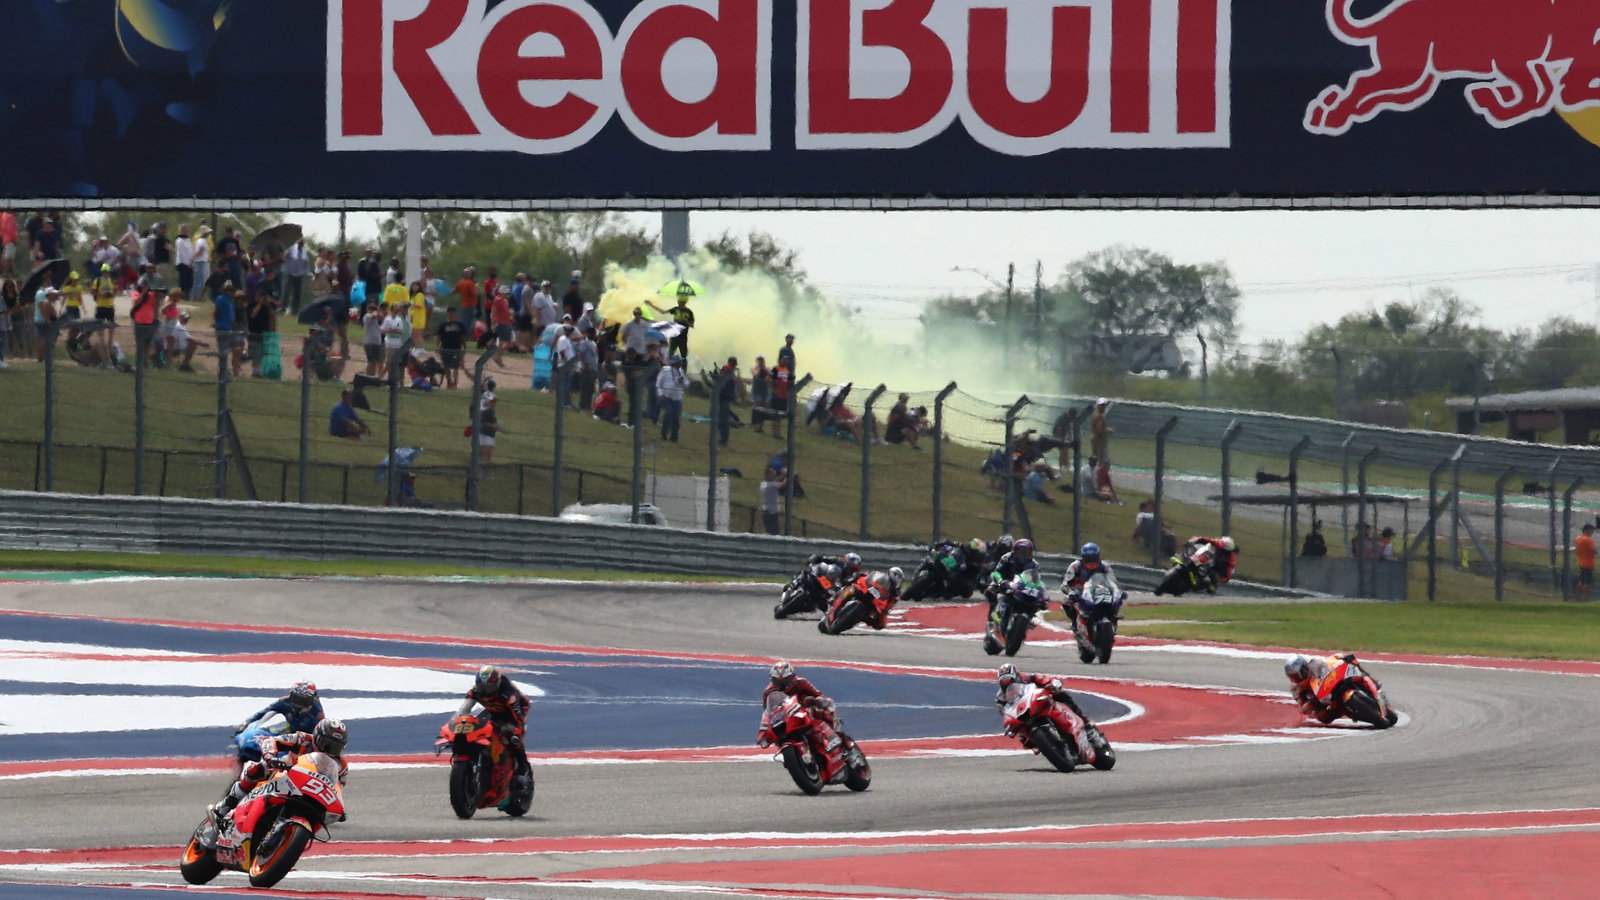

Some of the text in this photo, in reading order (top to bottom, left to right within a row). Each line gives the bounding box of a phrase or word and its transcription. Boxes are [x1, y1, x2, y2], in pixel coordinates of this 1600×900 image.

[340, 0, 1217, 140] Red Bull
[301, 778, 337, 805] 93
